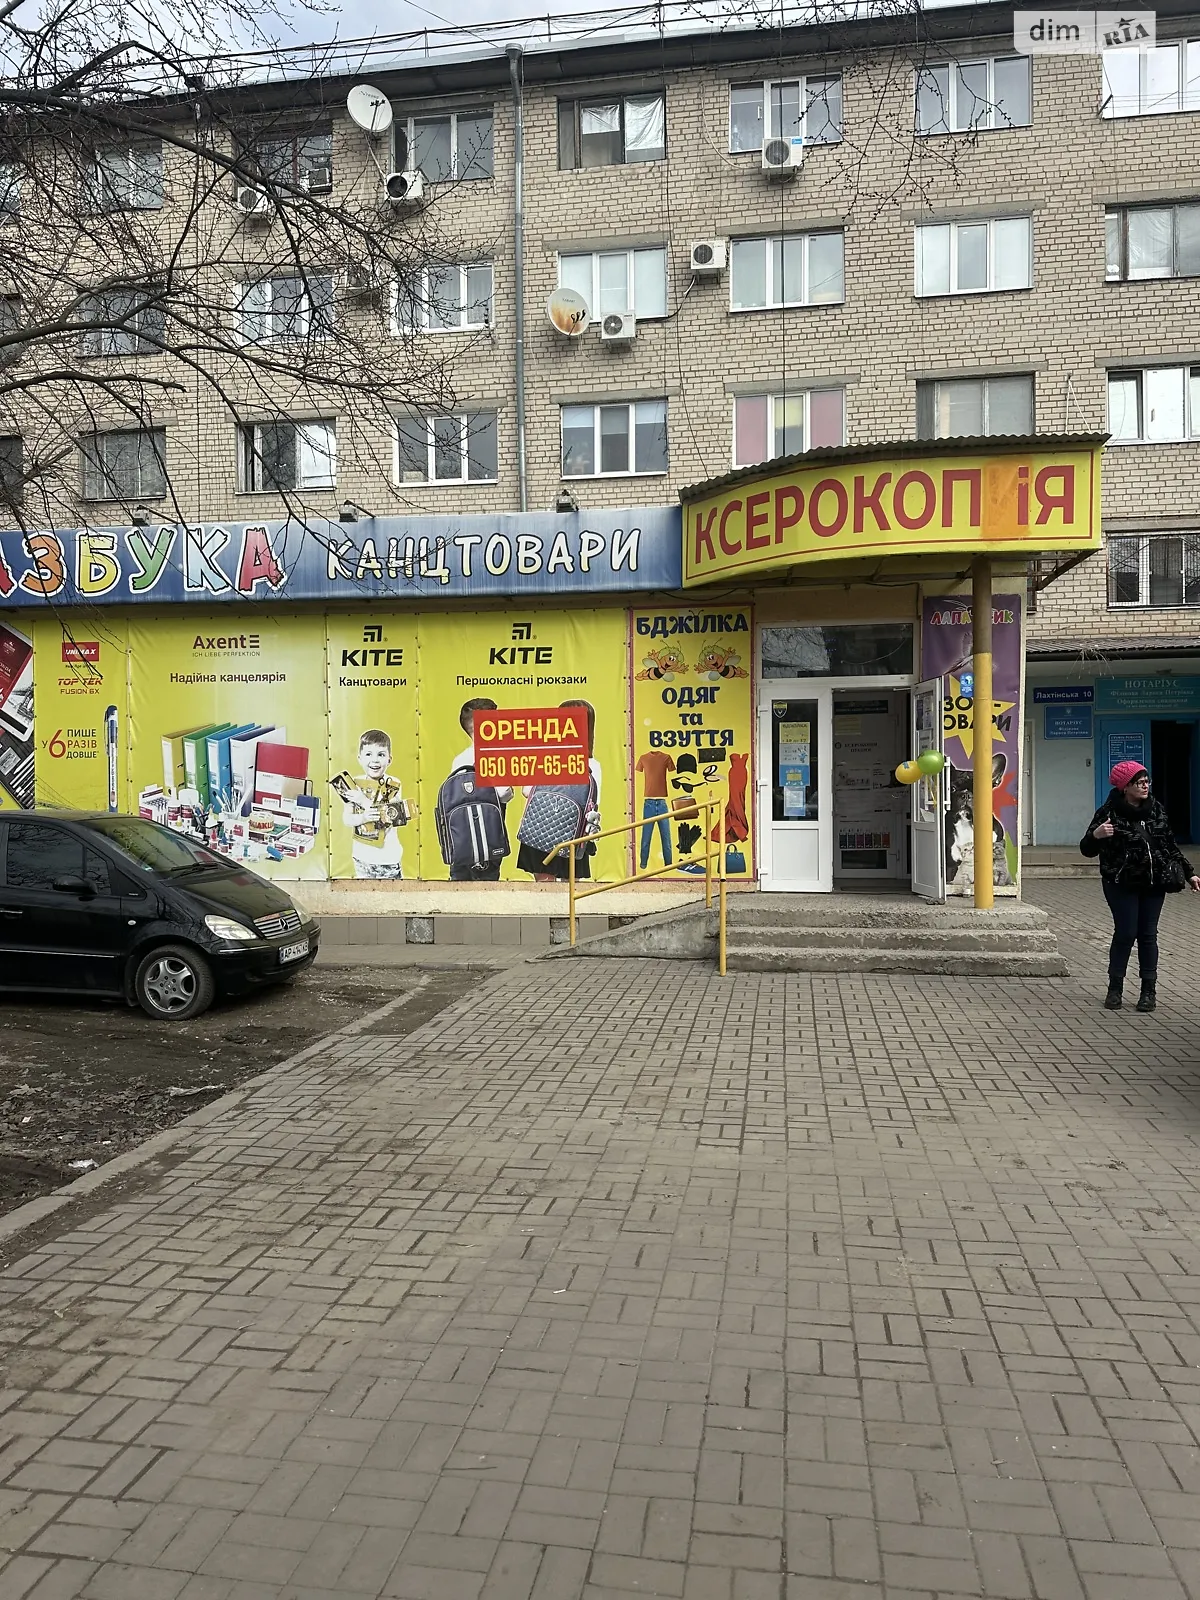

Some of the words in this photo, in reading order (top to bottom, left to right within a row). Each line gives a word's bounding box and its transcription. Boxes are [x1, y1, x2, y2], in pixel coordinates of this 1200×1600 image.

[326, 529, 641, 584] КАНЦТОВАРИ
[637, 614, 749, 639] БДЖІЛКА
[192, 635, 247, 649] Axent
[341, 649, 404, 667] KITE
[489, 647, 553, 665] KITE
[58, 678, 79, 686] TOP
[170, 672, 216, 684] Надійна
[220, 671, 286, 683] канцелярія
[339, 676, 407, 688] Канцтовари
[456, 674, 534, 687] Першокласні
[536, 675, 587, 687] рюкзаки
[1125, 679, 1178, 689] НОТАРІУС
[661, 686, 721, 708] ОДЯГ
[1036, 691, 1079, 699] Лахтінська
[679, 713, 703, 726] та
[67, 729, 97, 738] ПИШЕ
[479, 718, 579, 743] ОРЕНДА
[49, 729, 66, 758] 6
[67, 740, 97, 749] РАЗІВ
[649, 729, 734, 748] ВЗУТТЯ
[66, 750, 97, 759] ДОВШЕ
[479, 757, 506, 777] 050
[511, 755, 585, 776] 667-65-65
